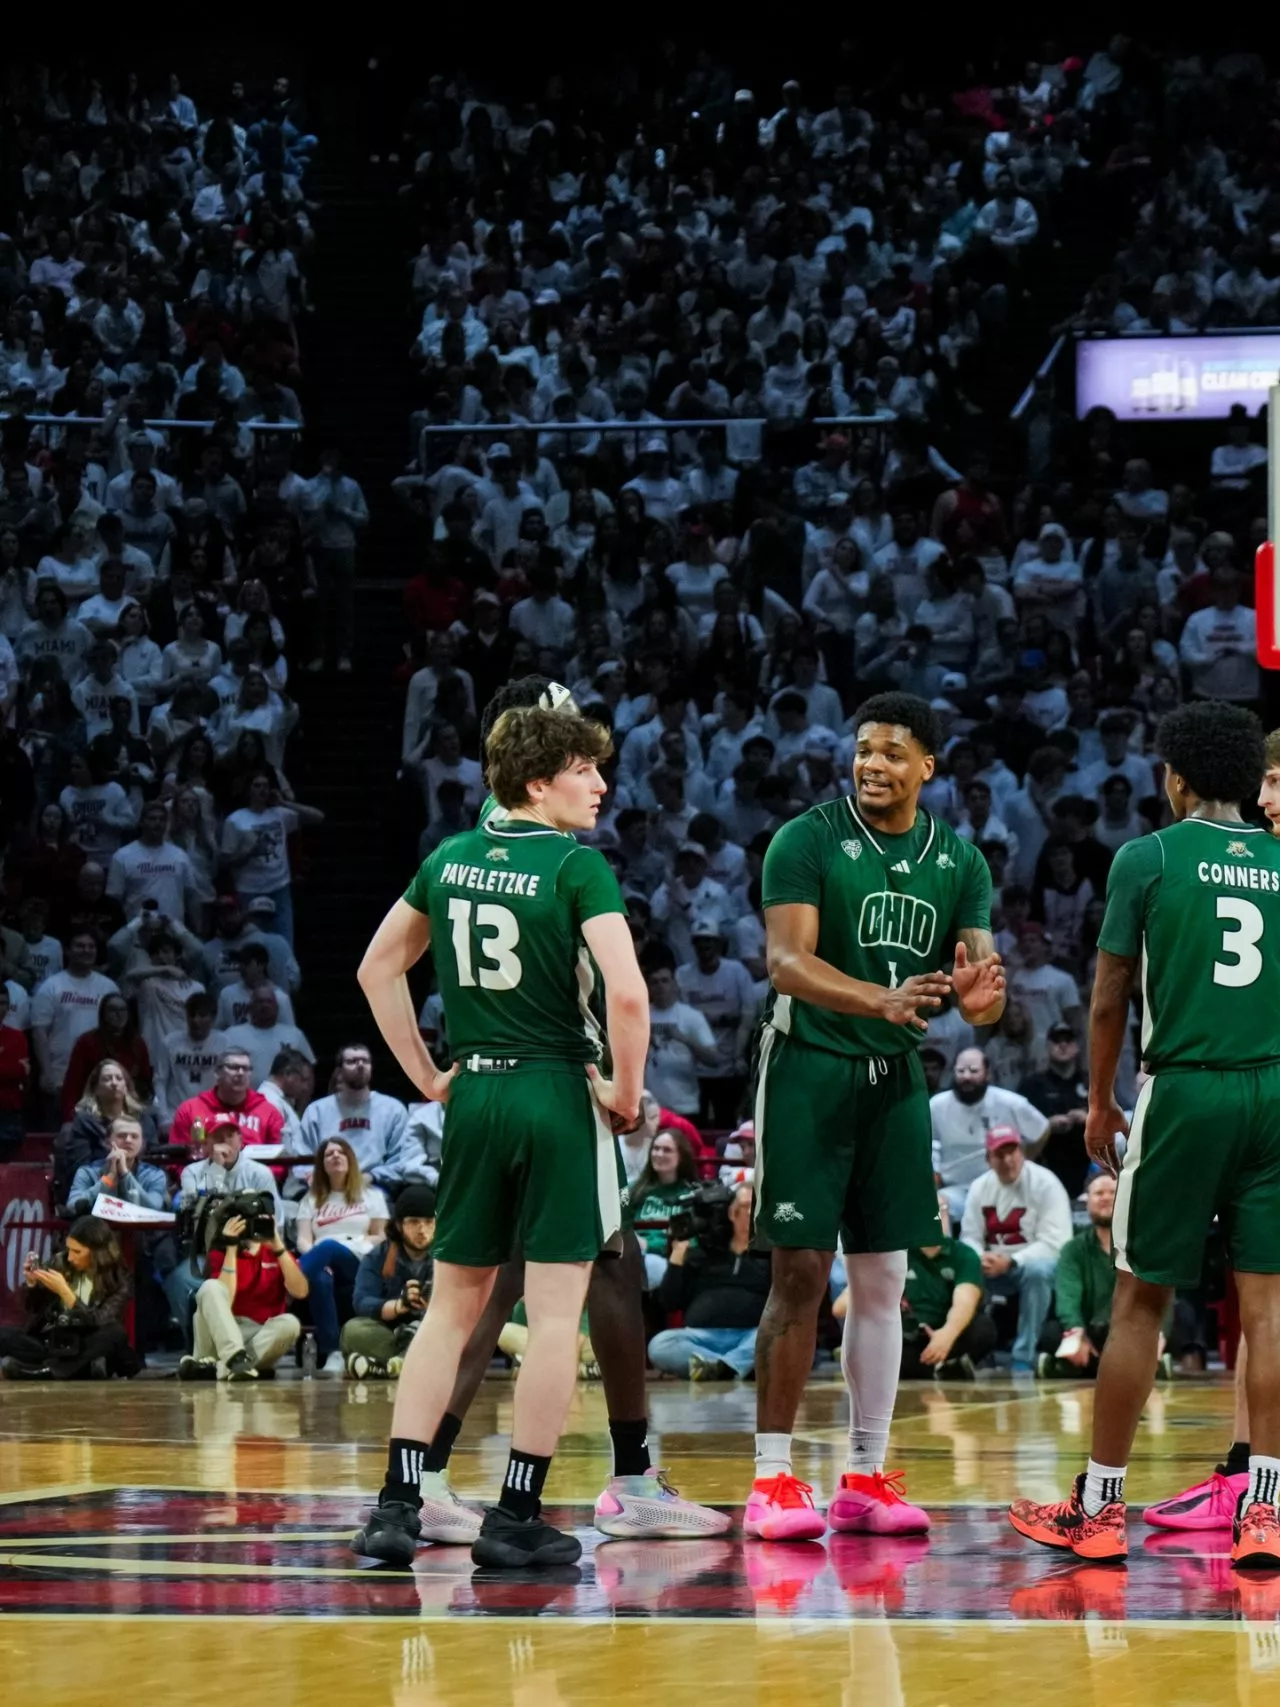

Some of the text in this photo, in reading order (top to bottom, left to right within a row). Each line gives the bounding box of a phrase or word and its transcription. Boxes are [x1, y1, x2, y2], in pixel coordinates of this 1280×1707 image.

[440, 862, 541, 897] PAVELETZKE
[1197, 861, 1280, 892] CONNERS
[447, 897, 523, 991] 13
[857, 890, 937, 958] OHIO
[1213, 896, 1264, 988] 3
